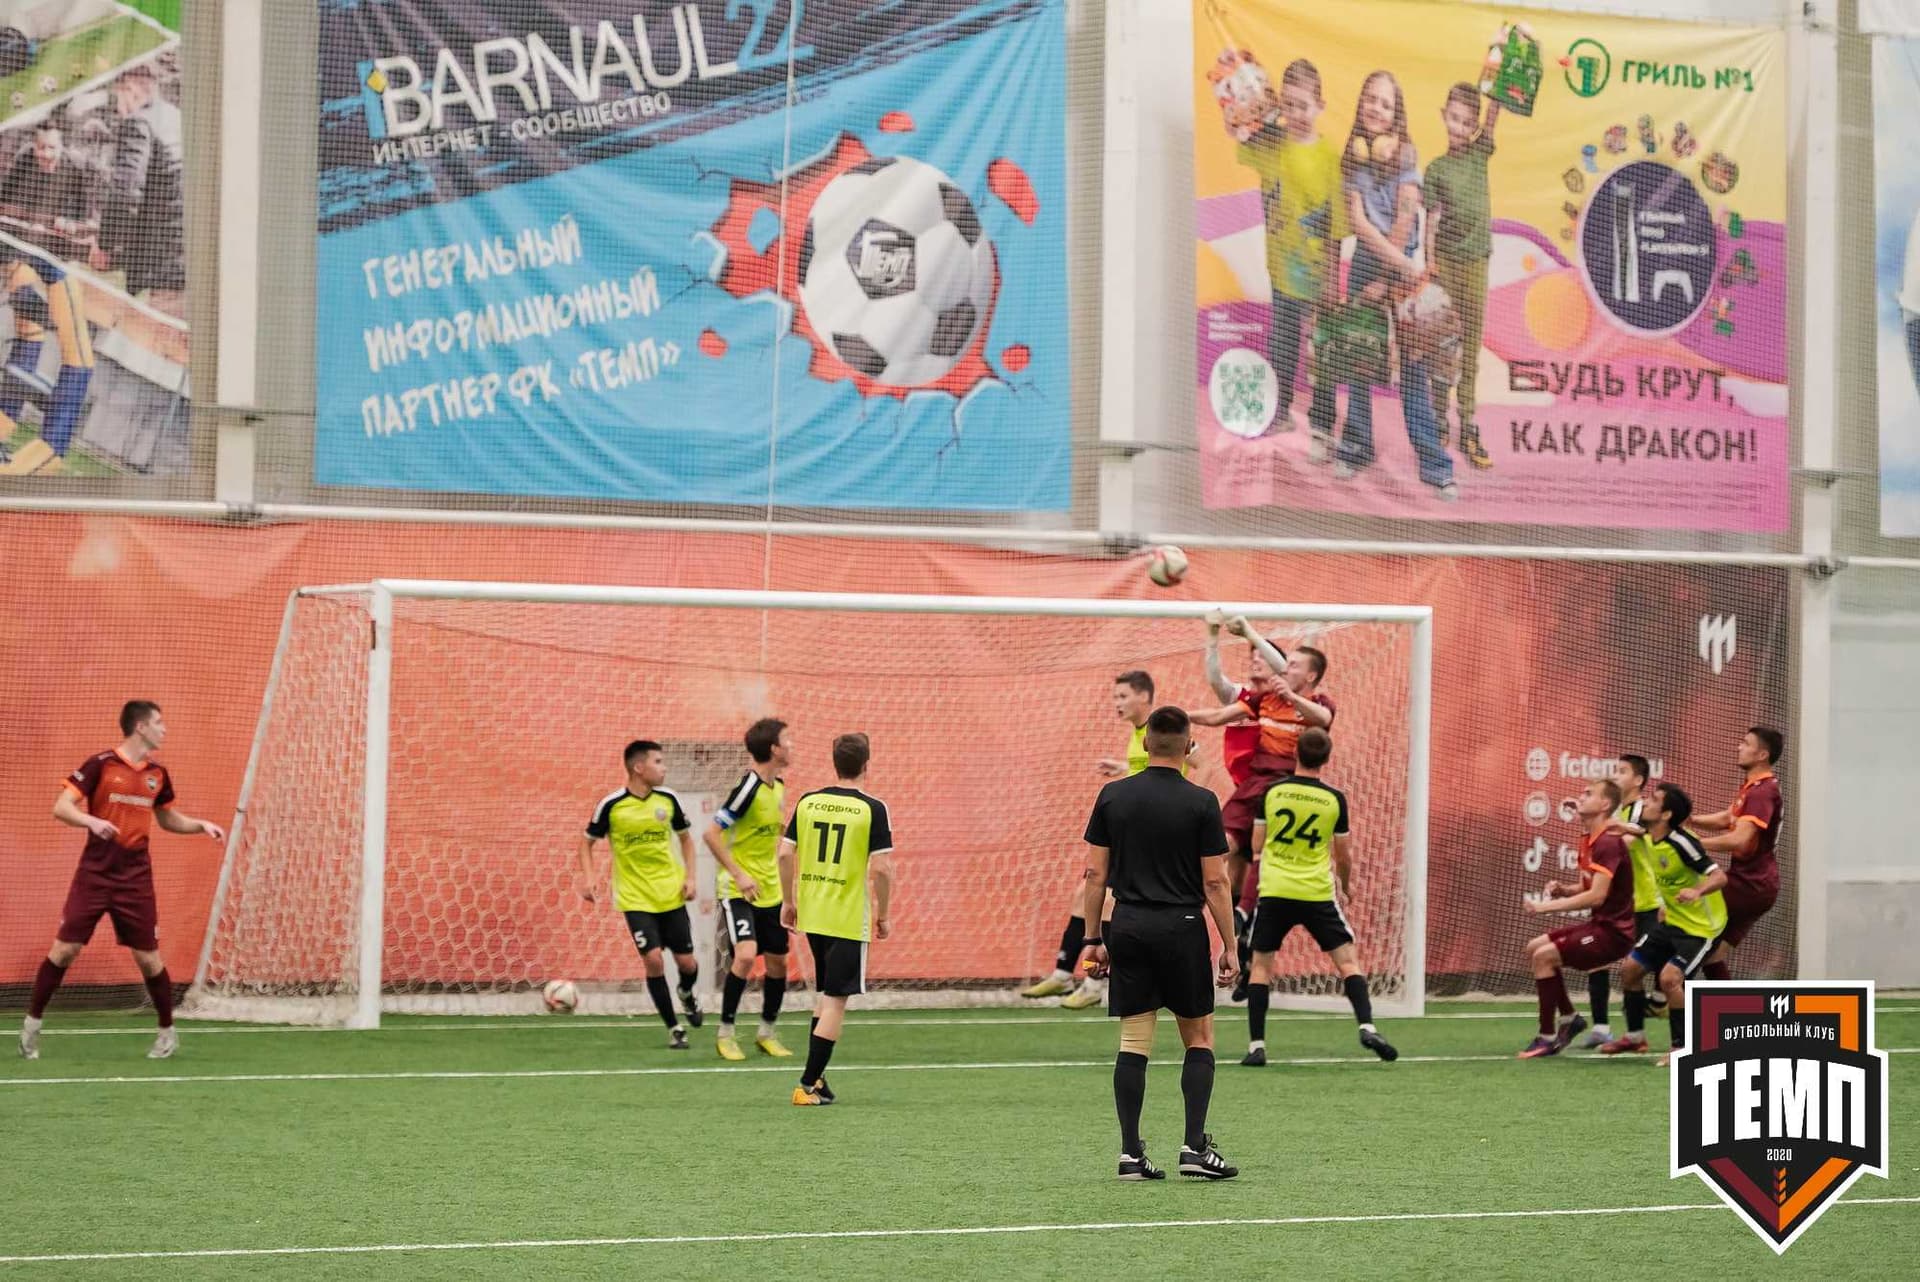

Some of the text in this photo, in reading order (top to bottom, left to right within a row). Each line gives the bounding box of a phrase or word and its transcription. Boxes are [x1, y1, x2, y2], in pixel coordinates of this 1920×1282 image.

[1622, 59, 1706, 89] ГРИЛЬ
[362, 212, 583, 299] ГЕНЕРАЛЬНЫЙ
[363, 265, 662, 373] ИНФОРМАЦИОННЫЙ
[362, 338, 681, 438] ПАРТНЕР ФК «ТЕМП»
[1507, 360, 1734, 408] БУДЬ КРУТ,
[1510, 420, 1759, 465] КАК ДРАКОН!
[813, 821, 847, 865] 11
[1273, 808, 1322, 849] 24
[633, 931, 647, 948] 5
[736, 919, 751, 936] 2
